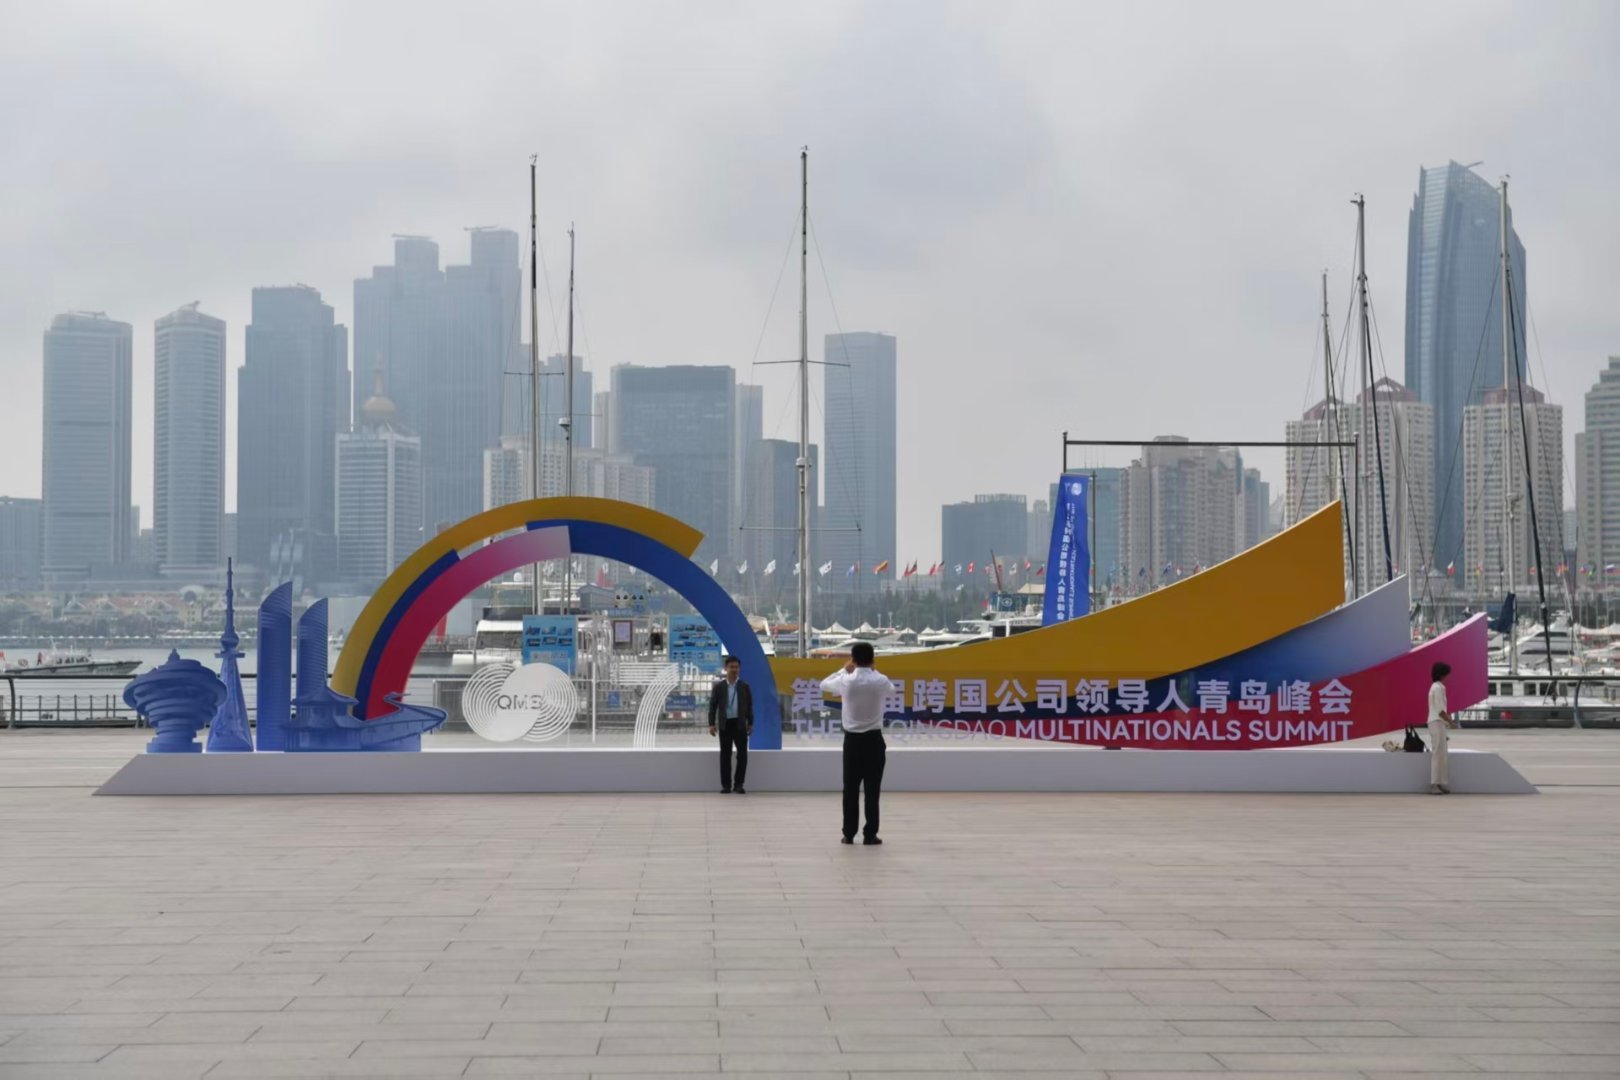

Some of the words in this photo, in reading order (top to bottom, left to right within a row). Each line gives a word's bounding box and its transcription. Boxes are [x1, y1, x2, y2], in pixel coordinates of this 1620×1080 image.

[497, 694, 542, 710] QMS
[792, 678, 1353, 714] 第届跨国公司领导人青岛峰会
[791, 719, 842, 740] THE
[889, 719, 1006, 743] QINGDAO
[1015, 719, 1241, 742] MULTINATIONALS
[1248, 719, 1353, 742] SUMMIT
